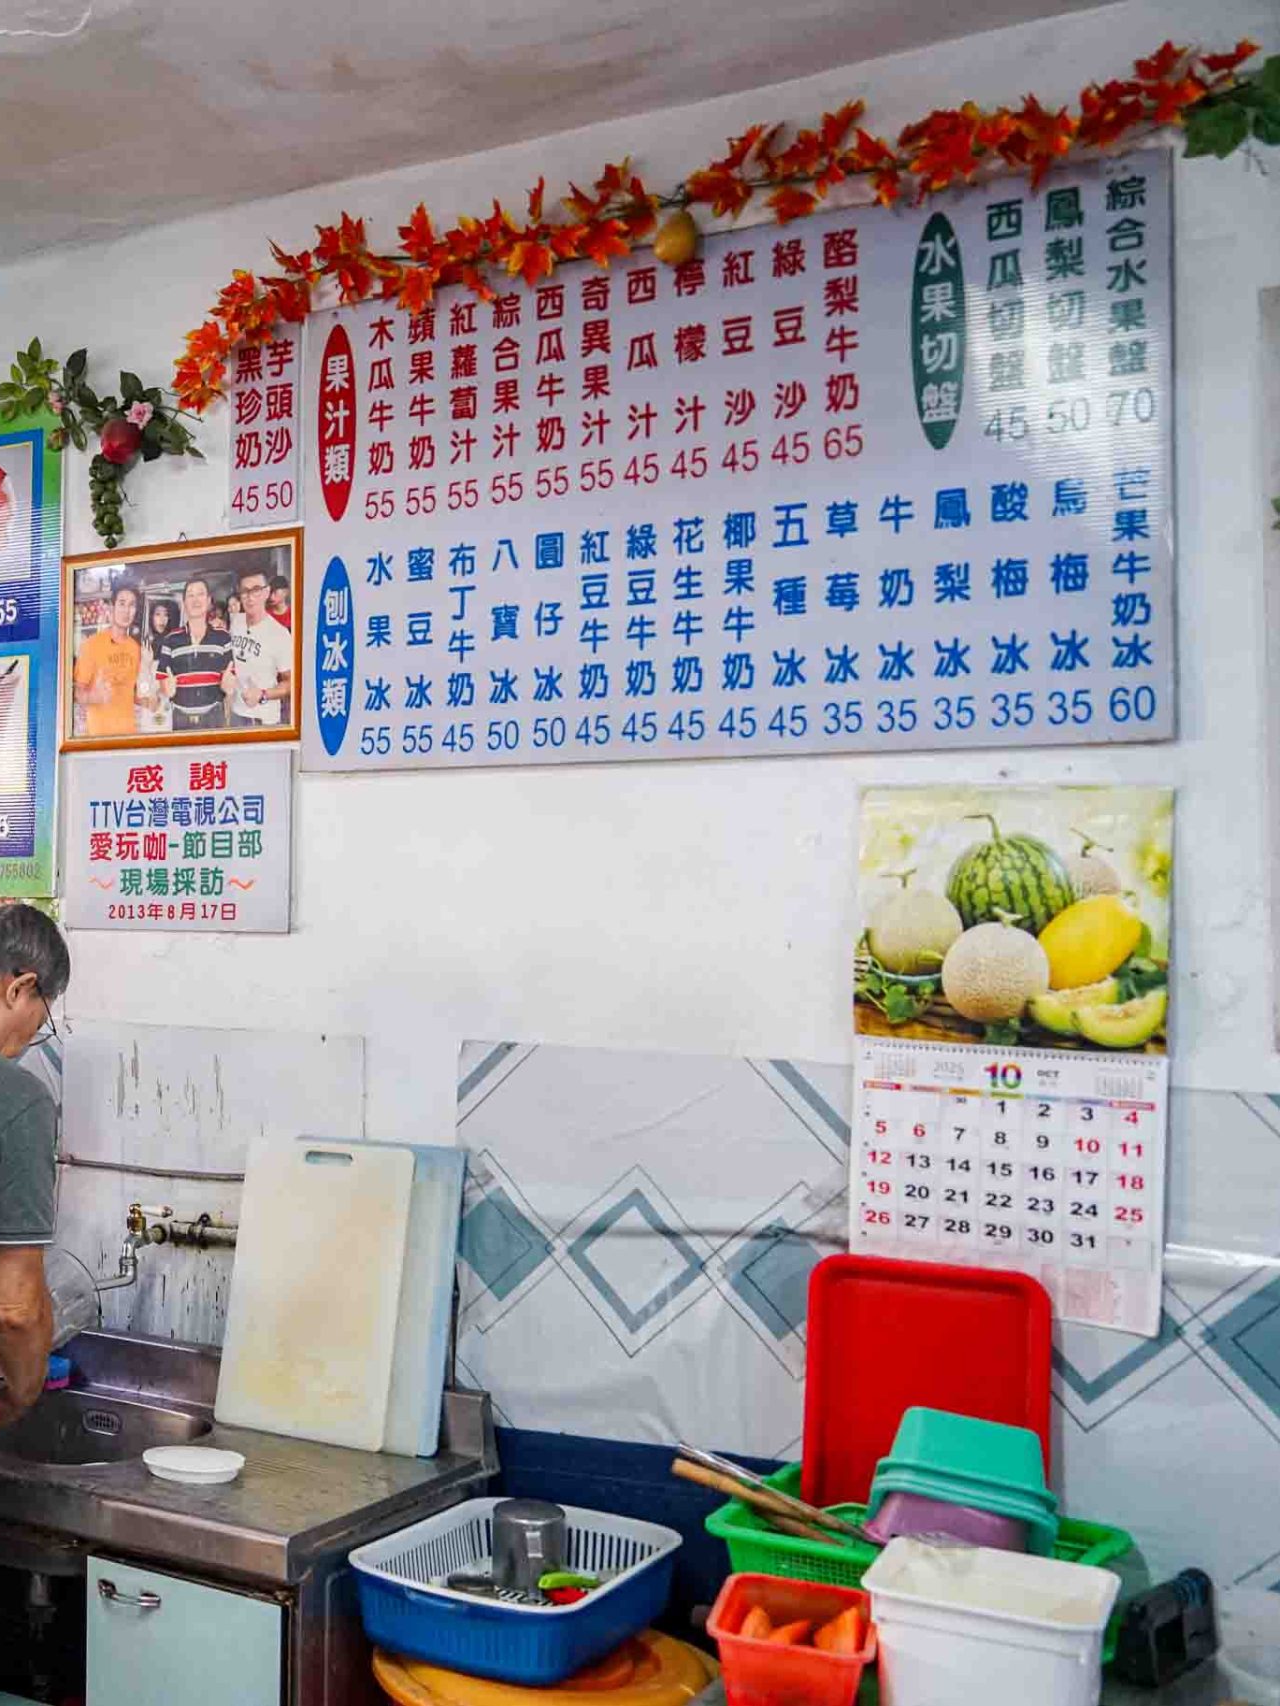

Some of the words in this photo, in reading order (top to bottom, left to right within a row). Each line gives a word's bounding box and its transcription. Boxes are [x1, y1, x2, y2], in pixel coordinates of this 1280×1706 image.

[1044, 184, 1087, 385] 鳳梨切盤
[1105, 173, 1147, 377] 綜合水果盤
[985, 197, 1026, 392] 西瓜切盤
[723, 250, 756, 426] 紅豆沙
[772, 239, 808, 420] 綠豆沙
[823, 227, 860, 413] 酪梨牛奶
[920, 236, 957, 424] 水果切盤
[581, 276, 612, 445] 奇異果汁
[625, 261, 660, 441] 西瓜汁
[673, 258, 707, 435] 檸檬汁
[450, 299, 483, 461] 紅蘿蔔汁
[489, 289, 521, 457] 綜合果汁
[531, 281, 566, 451] 西瓜牛奶
[265, 338, 294, 467] 芋頭沙
[367, 317, 395, 475] 木瓜牛奶
[407, 306, 437, 471] 蘋果牛奶
[1106, 386, 1154, 427] 70
[234, 346, 263, 471] 黑珍奶
[323, 354, 350, 487] 果汁類
[983, 405, 1031, 443] 45
[1045, 396, 1090, 434] 50
[723, 437, 761, 473] 45
[769, 432, 812, 465] 45
[822, 423, 865, 461] 65
[534, 464, 571, 500] 55
[578, 458, 617, 492] 55
[622, 452, 661, 485] 45
[671, 447, 709, 481] 45
[231, 484, 259, 514] 45
[264, 476, 295, 513] 50
[364, 488, 397, 522] 55
[405, 484, 437, 517] 55
[444, 477, 481, 509] 55
[488, 471, 525, 506] 55
[933, 487, 972, 679] 鳳梨冰
[991, 483, 1030, 674] 酸梅冰
[1051, 480, 1090, 673] 烏梅冰
[1109, 468, 1153, 670] 芒果牛奶冰
[672, 517, 705, 694] 花生牛奶
[723, 512, 756, 690] 椰果牛奶
[772, 501, 808, 689] 五種冰
[824, 501, 859, 685] 草莓冰
[877, 496, 916, 682] 牛奶冰
[404, 547, 433, 709] 蜜豆冰
[446, 545, 477, 707] 布丁牛奶
[489, 538, 519, 705] 八寶冰
[533, 532, 566, 702] 圓仔冰
[579, 530, 610, 700] 紅豆牛奶
[625, 523, 657, 697] 綠豆牛奶
[364, 555, 391, 711] 水果冰
[321, 586, 354, 719] 刨冰類
[664, 705, 706, 742] 45
[718, 704, 758, 739] 45
[767, 704, 808, 738] 45
[821, 699, 865, 735] 35
[876, 698, 919, 733] 35
[933, 694, 976, 731] 35
[991, 690, 1035, 730] 35
[1046, 688, 1093, 727] 35
[1107, 687, 1157, 724] 60
[357, 724, 393, 757] 55
[401, 720, 434, 756] 55
[441, 721, 475, 753] 45
[486, 717, 521, 752] 50
[530, 716, 567, 749] 50
[575, 712, 613, 746] 45
[620, 709, 658, 743] 45
[127, 762, 228, 794] 感謝
[88, 793, 265, 829] TTV台灣電視公司
[89, 828, 263, 862] 愛玩咖-節目部
[119, 867, 225, 897] 現場採訪
[108, 901, 238, 921] 2013年8月17日
[984, 1062, 1023, 1090] 10
[1036, 1069, 1060, 1079] OCT
[997, 1101, 1006, 1113] 1
[1038, 1103, 1051, 1117] 2
[1080, 1107, 1094, 1121] 3
[1123, 1111, 1138, 1124] 4
[876, 1120, 886, 1133] 5
[913, 1124, 925, 1137] 6
[954, 1128, 965, 1140] 7
[994, 1132, 1006, 1144] 8
[1036, 1135, 1049, 1148] 9
[1075, 1138, 1100, 1153] 10
[1119, 1142, 1142, 1158] 11
[868, 1151, 892, 1164] 12
[906, 1155, 930, 1168] 13
[946, 1159, 971, 1172] 14
[986, 1162, 1012, 1176] 15
[1030, 1167, 1055, 1181] 16
[1072, 1171, 1098, 1185] 17
[1117, 1175, 1143, 1189] 18
[867, 1181, 890, 1194] 19
[905, 1185, 929, 1198] 20
[945, 1189, 968, 1203] 21
[986, 1193, 1012, 1207] 22
[1028, 1198, 1054, 1212] 23
[1071, 1202, 1098, 1217] 24
[1114, 1207, 1143, 1222] 25
[865, 1210, 890, 1224] 26
[905, 1214, 929, 1228] 27
[945, 1219, 970, 1233] 28
[985, 1224, 1012, 1238] 29
[1028, 1229, 1053, 1243] 30
[1071, 1233, 1095, 1248] 31
